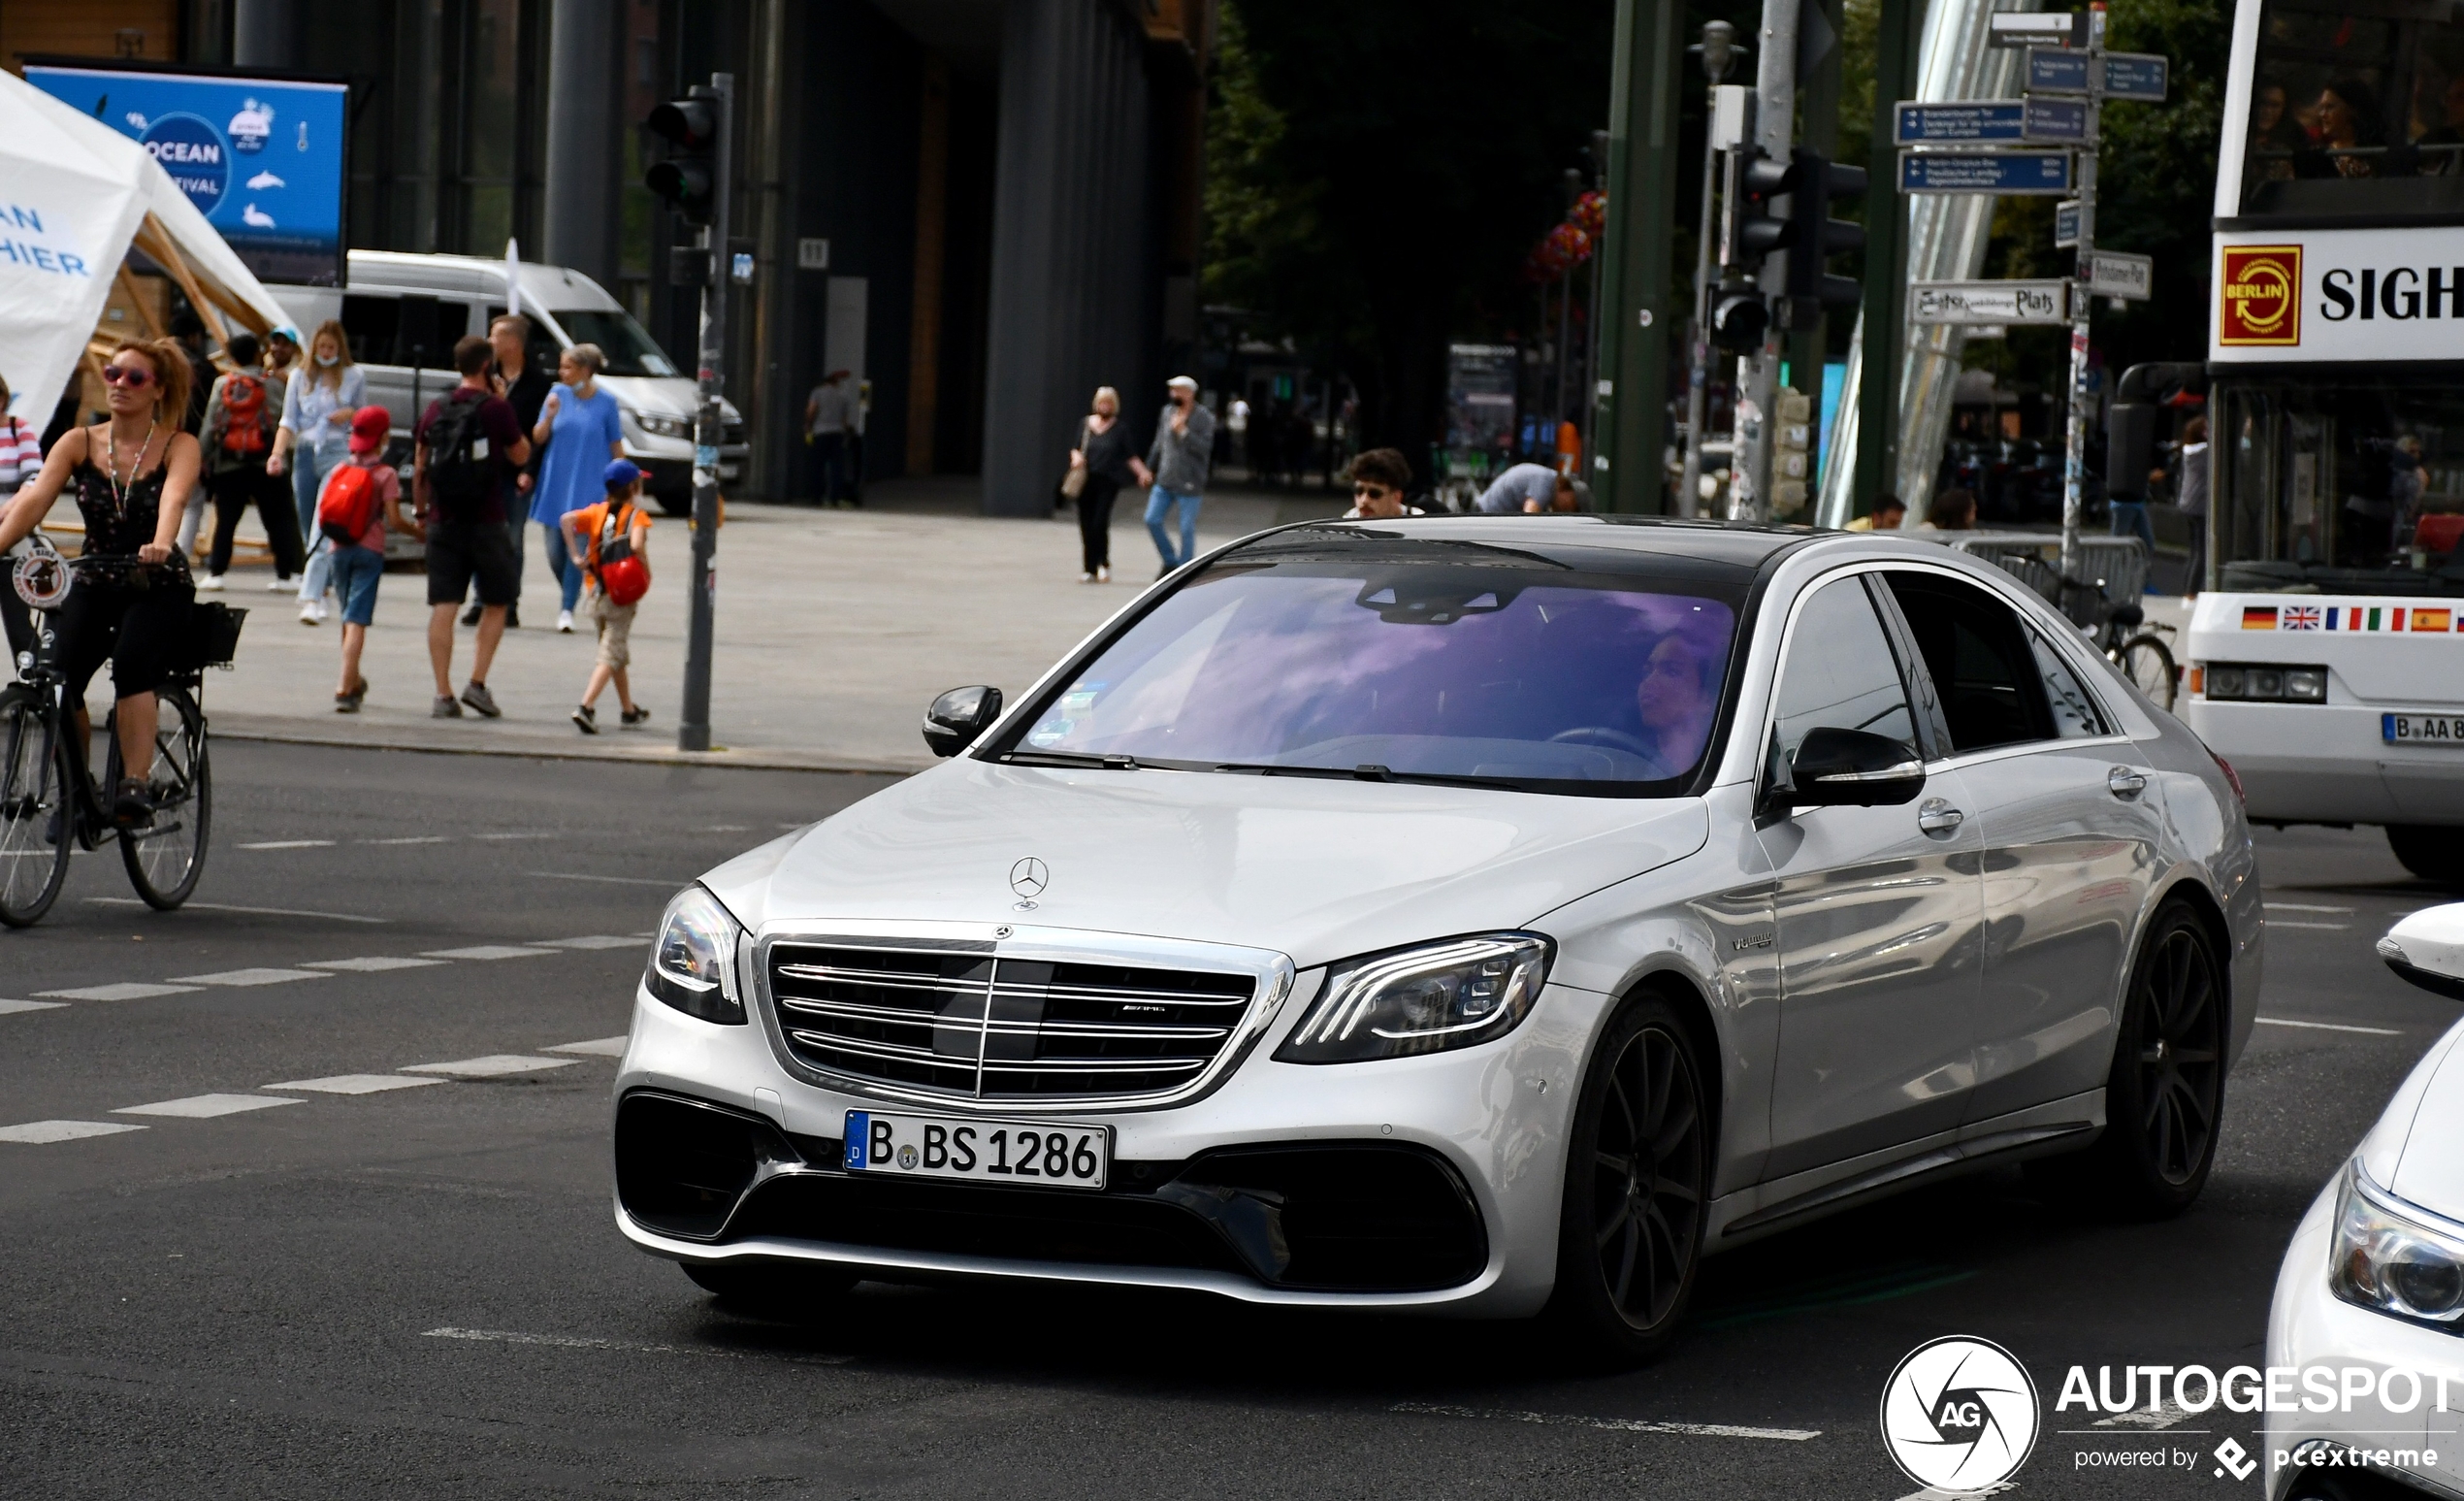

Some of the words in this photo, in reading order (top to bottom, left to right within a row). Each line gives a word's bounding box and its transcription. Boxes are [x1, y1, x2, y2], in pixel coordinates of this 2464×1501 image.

[146, 141, 219, 164] OCEAN
[2226, 284, 2283, 299] BERLIN
[2320, 267, 2464, 321] SIGH
[2396, 719, 2410, 737] B
[2424, 720, 2449, 738] AA
[852, 1146, 859, 1158] D
[869, 1120, 893, 1164] B
[923, 1124, 977, 1171] BS
[988, 1129, 1098, 1179] 1286
